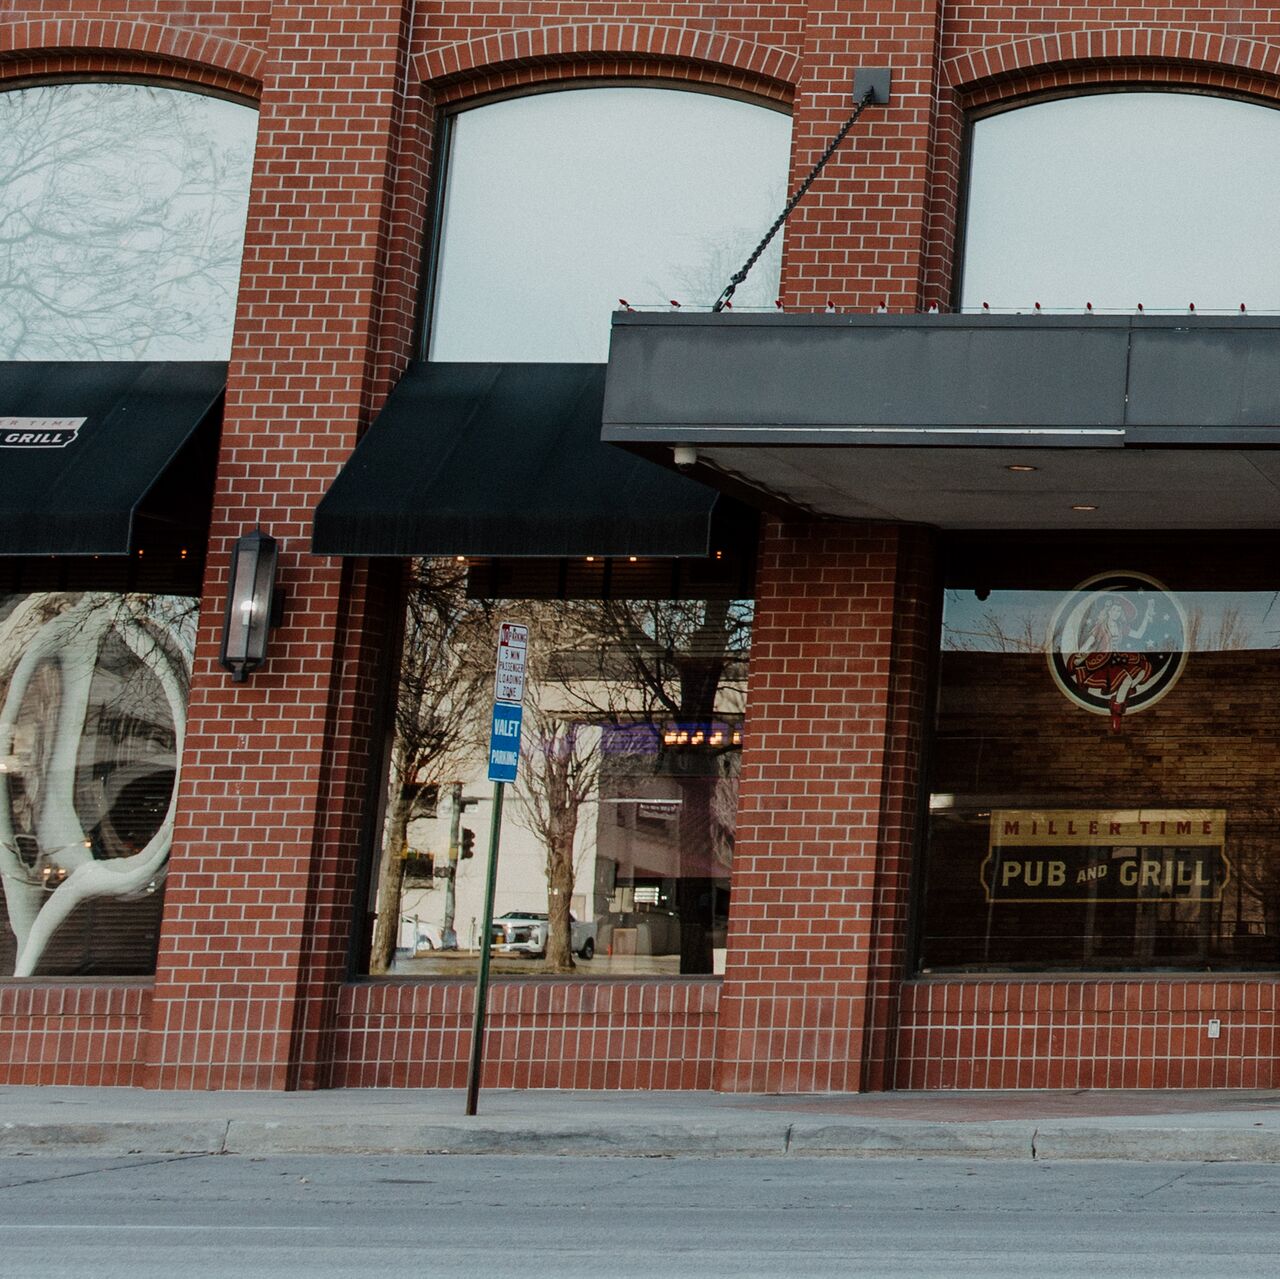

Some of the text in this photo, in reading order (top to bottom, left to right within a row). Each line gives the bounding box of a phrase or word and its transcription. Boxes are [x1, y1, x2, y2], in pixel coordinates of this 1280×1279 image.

[4, 433, 62, 443] GRILL
[499, 661, 524, 672] PASSENGER
[499, 673, 522, 685] LOADING
[502, 685, 517, 697] ZONE
[494, 718, 520, 737] VALET
[491, 749, 518, 766] PARKING
[1004, 820, 1212, 835] MILLER TIME
[1001, 860, 1210, 887] PUB AND GRILL
